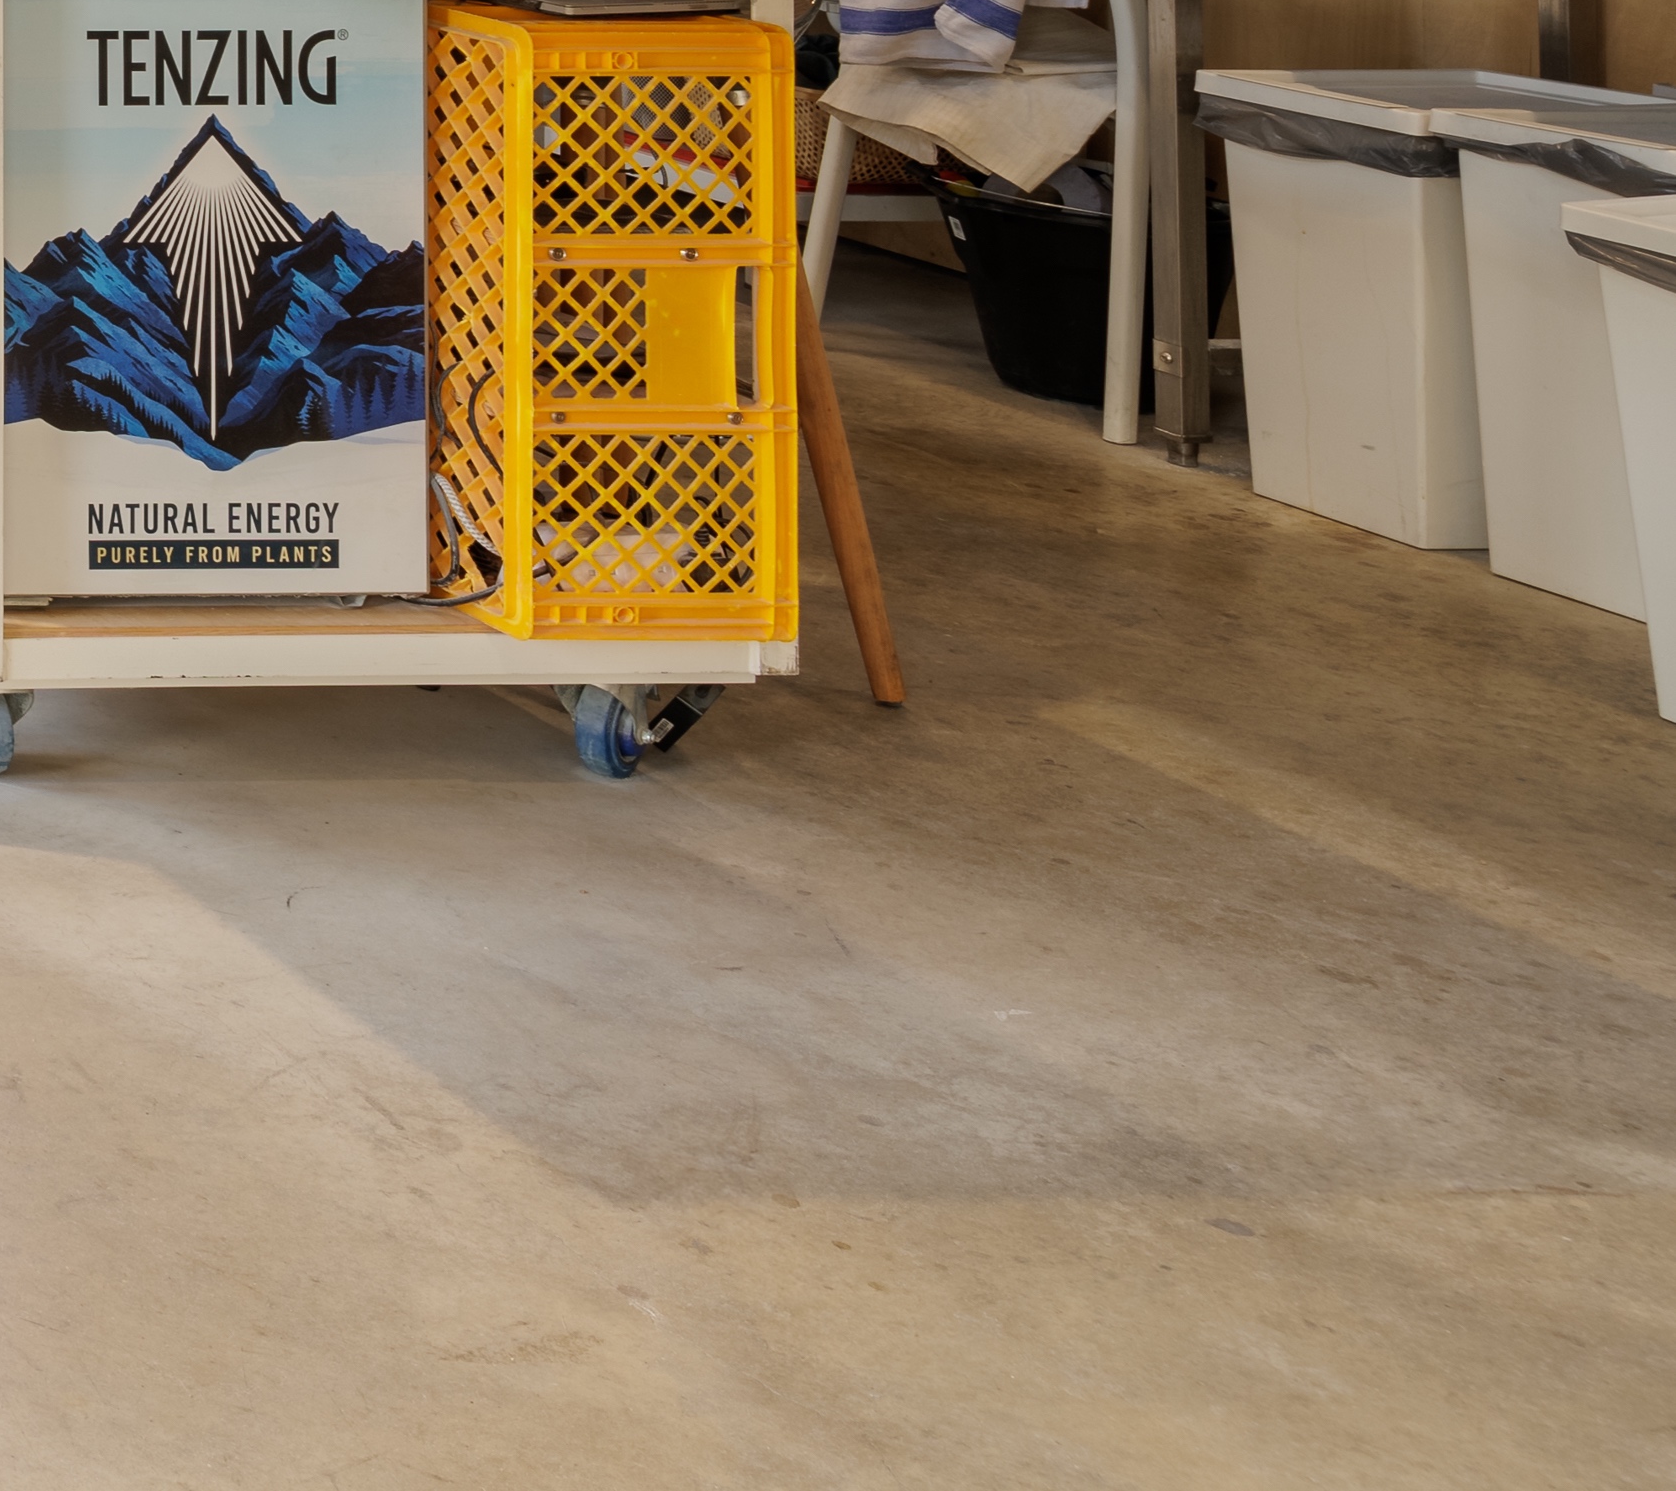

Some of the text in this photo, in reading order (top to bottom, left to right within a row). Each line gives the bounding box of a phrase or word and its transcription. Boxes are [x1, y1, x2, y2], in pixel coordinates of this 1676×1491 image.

[88, 503, 340, 534] NATURAL ENERGY
[96, 545, 332, 564] PURELY FROM PLANTS
